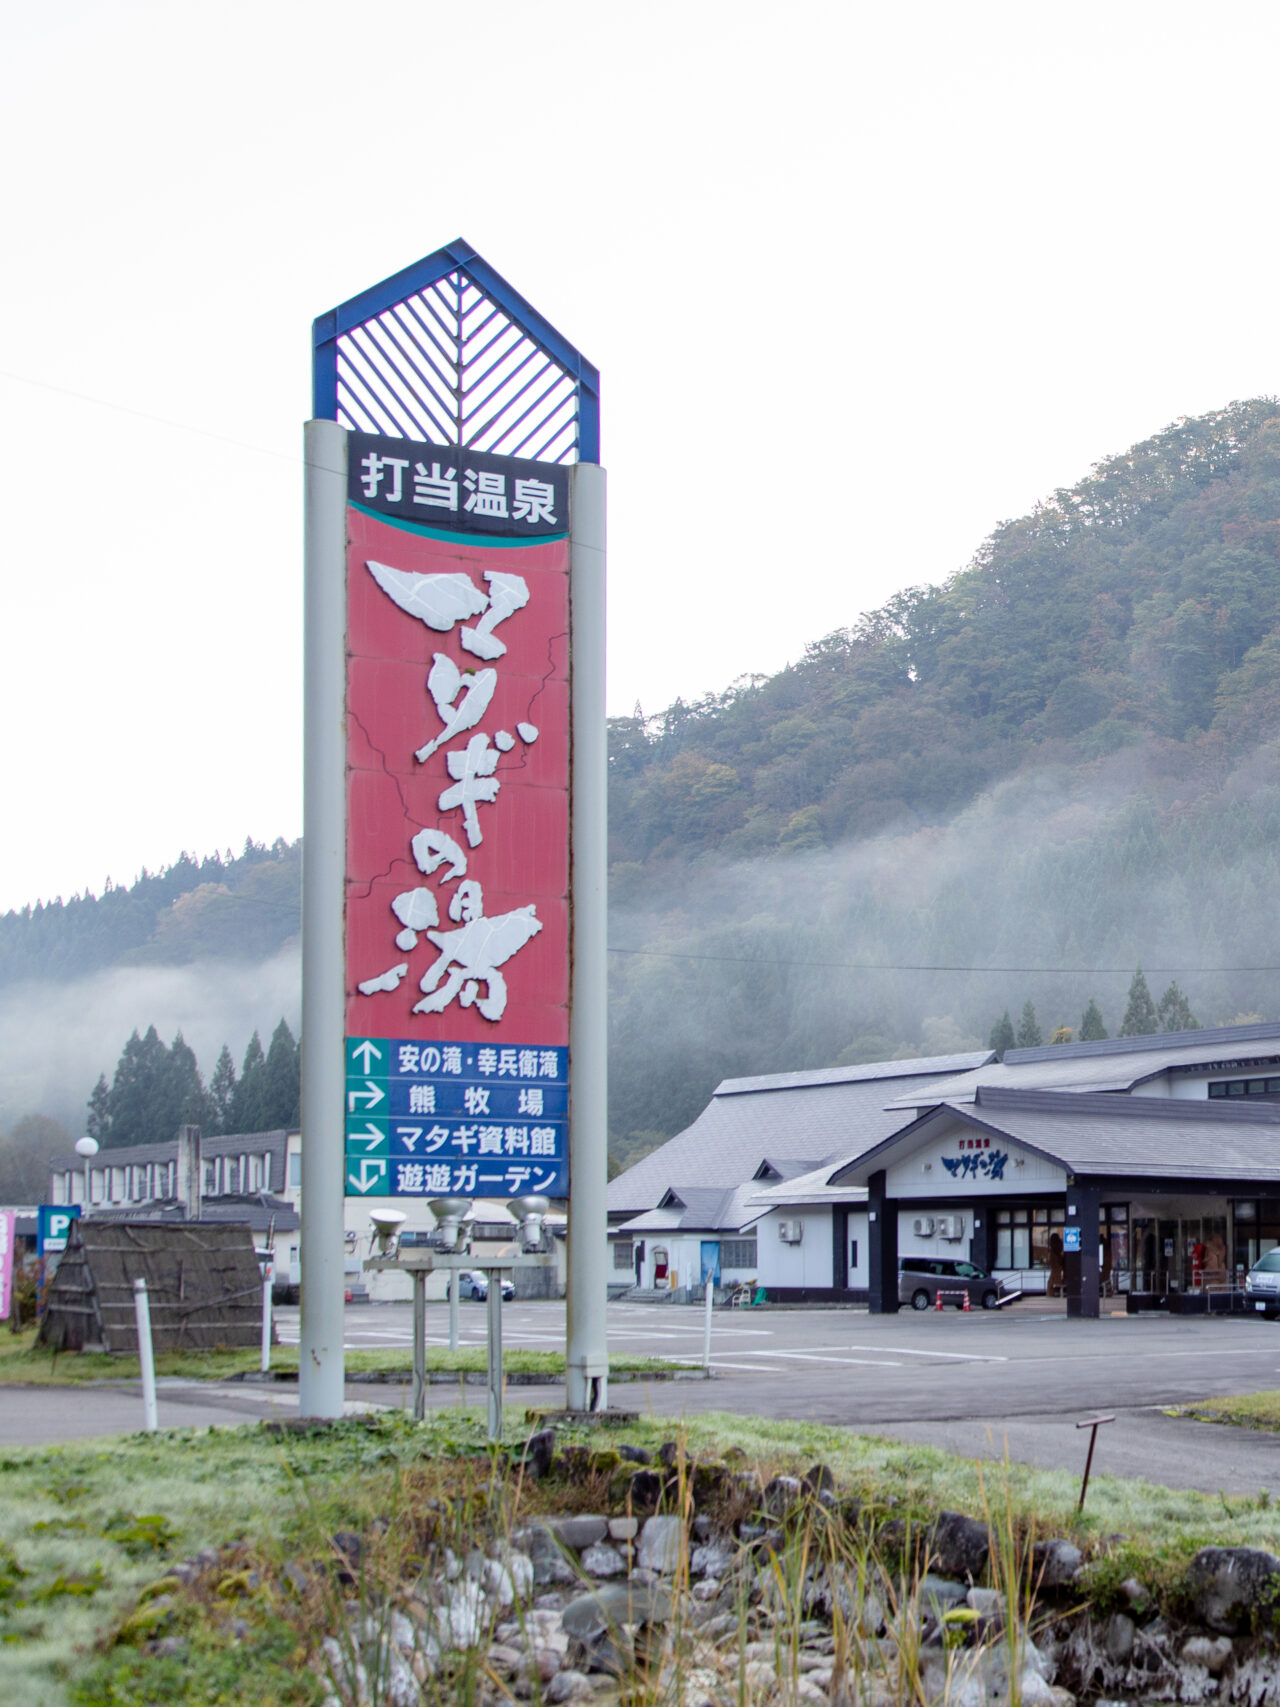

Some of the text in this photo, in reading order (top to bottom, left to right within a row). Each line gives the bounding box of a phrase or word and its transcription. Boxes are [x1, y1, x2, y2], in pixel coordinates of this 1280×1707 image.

[360, 452, 558, 525] 打当温泉
[358, 560, 543, 1022] マタギの湯
[396, 1124, 556, 1155] マタギ資料館
[397, 1163, 557, 1193] 遊遊ガーデン
[50, 1214, 71, 1237] P
